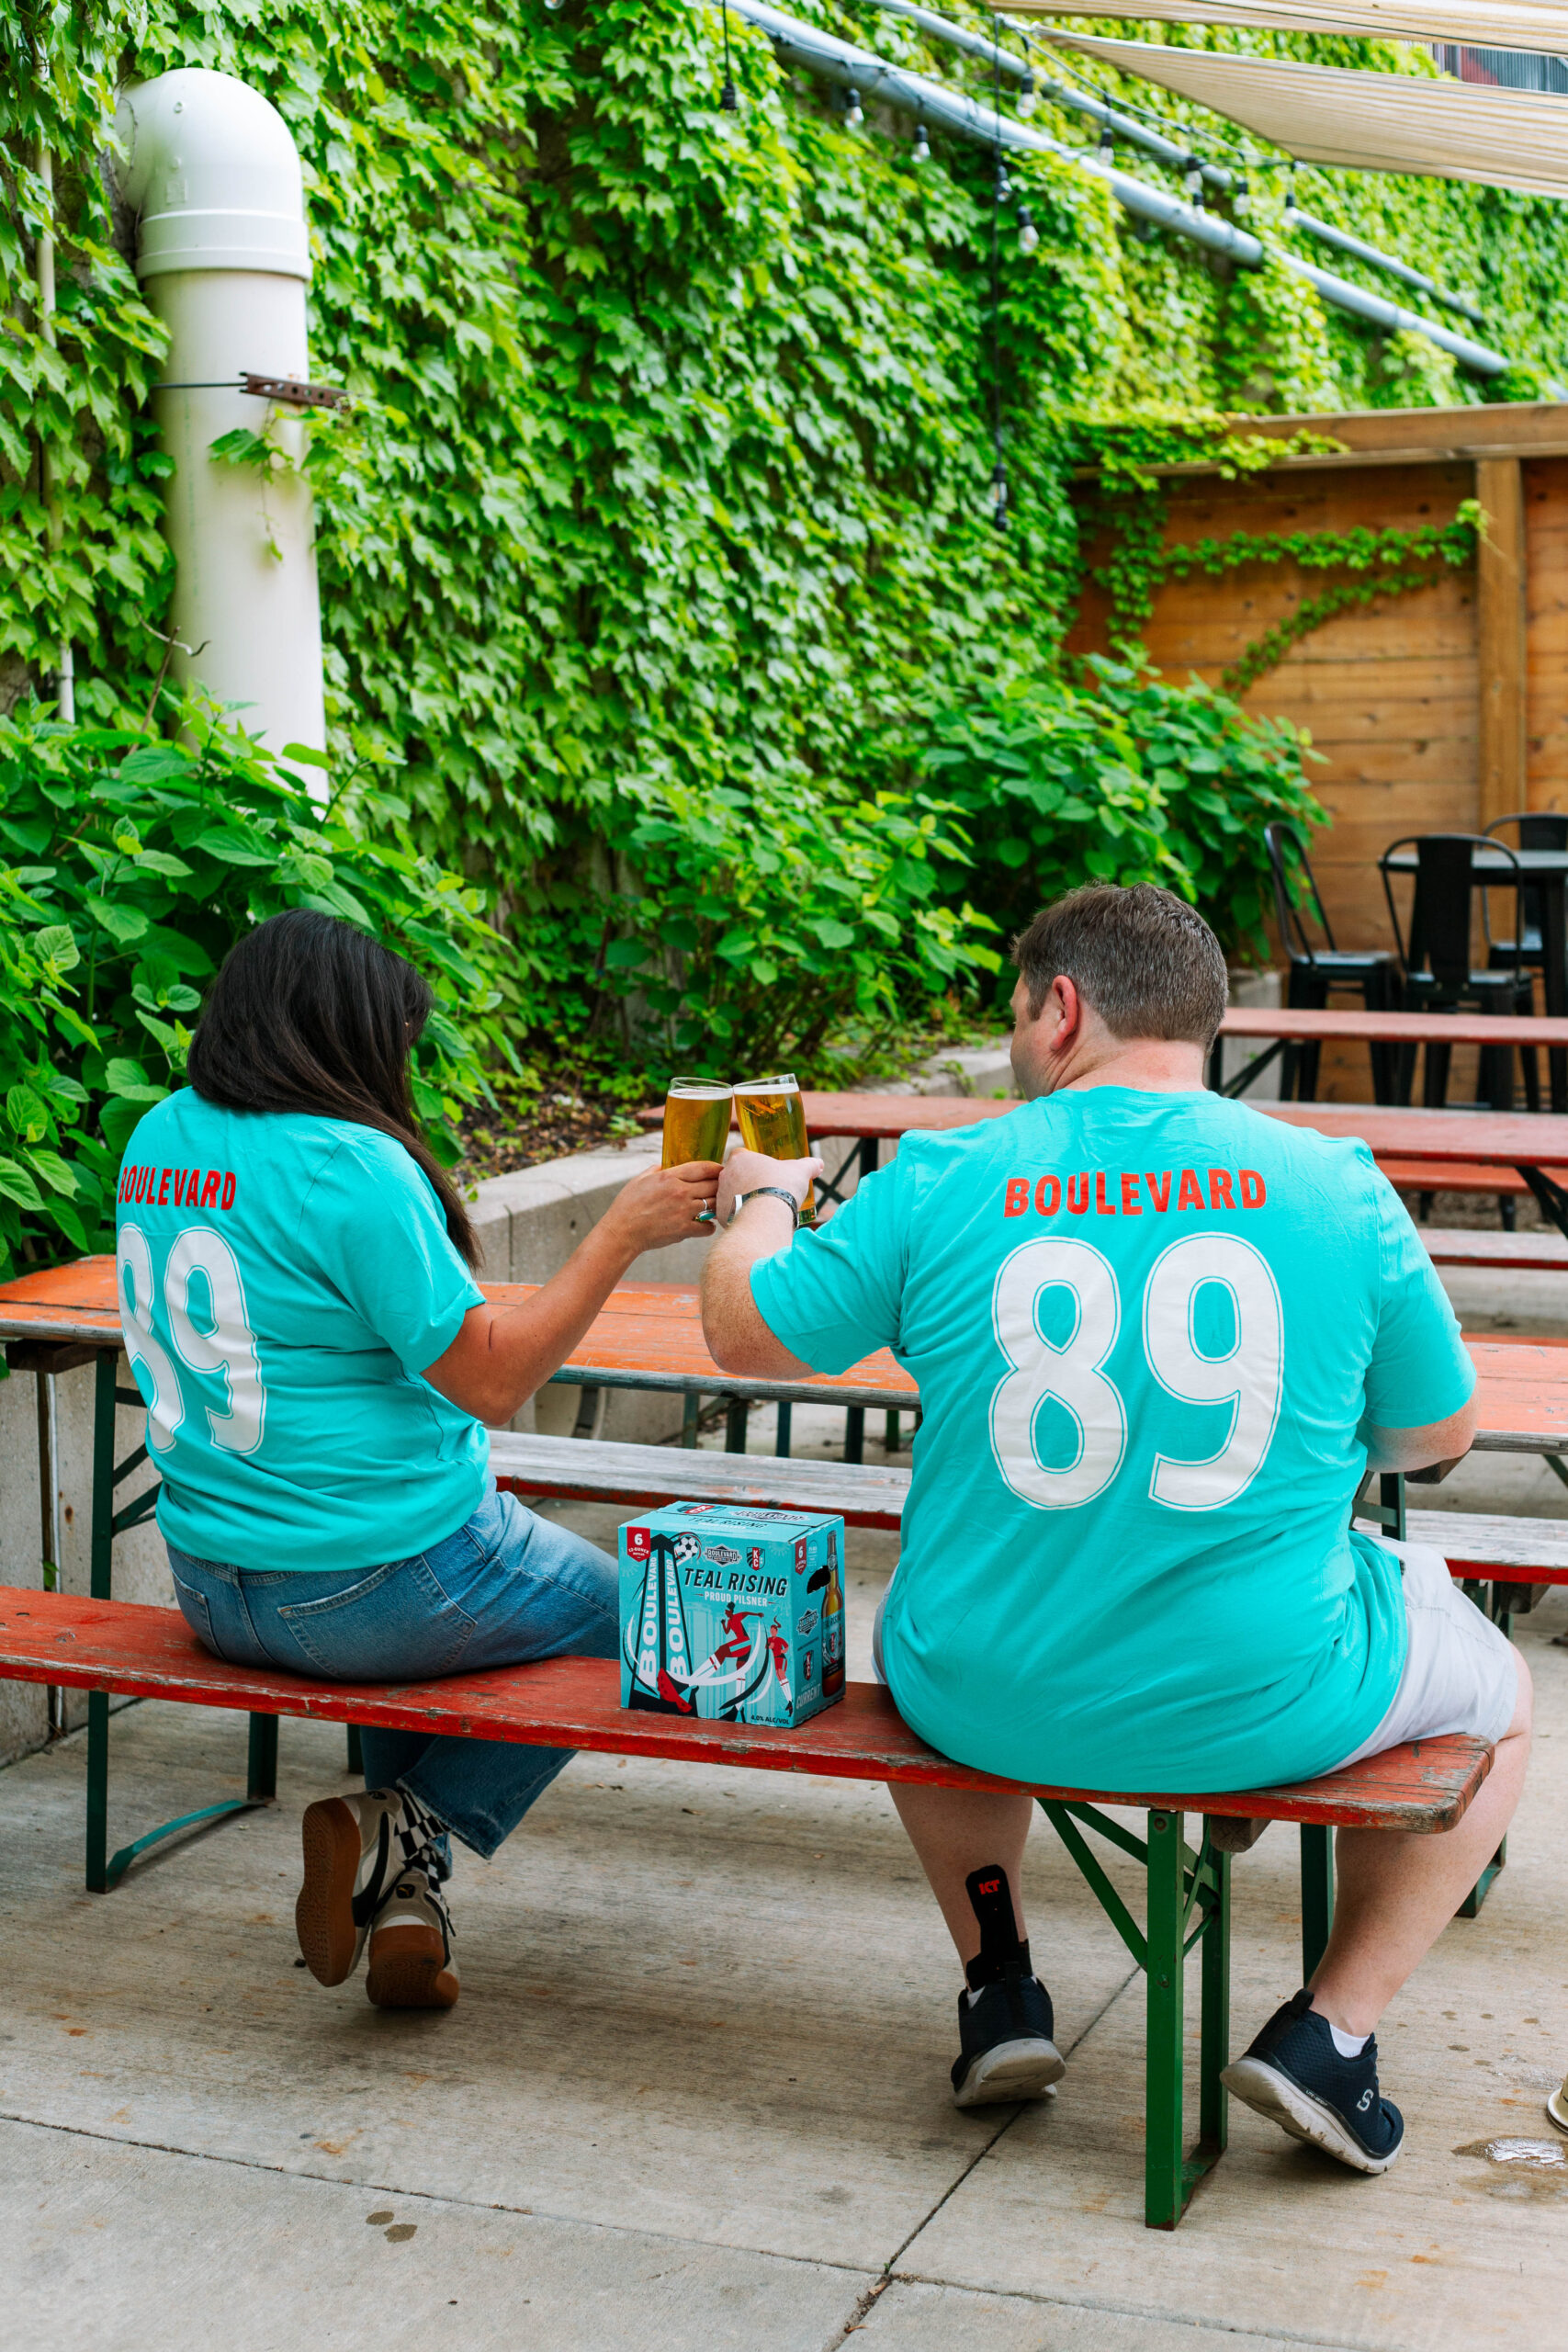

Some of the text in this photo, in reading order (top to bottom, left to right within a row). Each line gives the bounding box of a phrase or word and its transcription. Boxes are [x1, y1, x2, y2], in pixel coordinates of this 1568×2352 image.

[118, 1165, 237, 1210] BOULEVARD
[1004, 1169, 1267, 1217] BOULEVARD
[117, 1222, 266, 1456] 89
[988, 1231, 1284, 1511] 89
[634, 1533, 643, 1546] 6
[798, 1545, 804, 1559] 6
[707, 1549, 738, 1562] BOULEVARD
[684, 1567, 789, 1598] TEAL RISING
[704, 1591, 768, 1608] PROUD PILSNER
[637, 1556, 658, 1689] BOULEVARD
[666, 1558, 689, 1679] BOULEVARD
[795, 1683, 821, 1710] CURRENT
[765, 1716, 790, 1724] ALC/VOL
[978, 1879, 1000, 1895] KT
